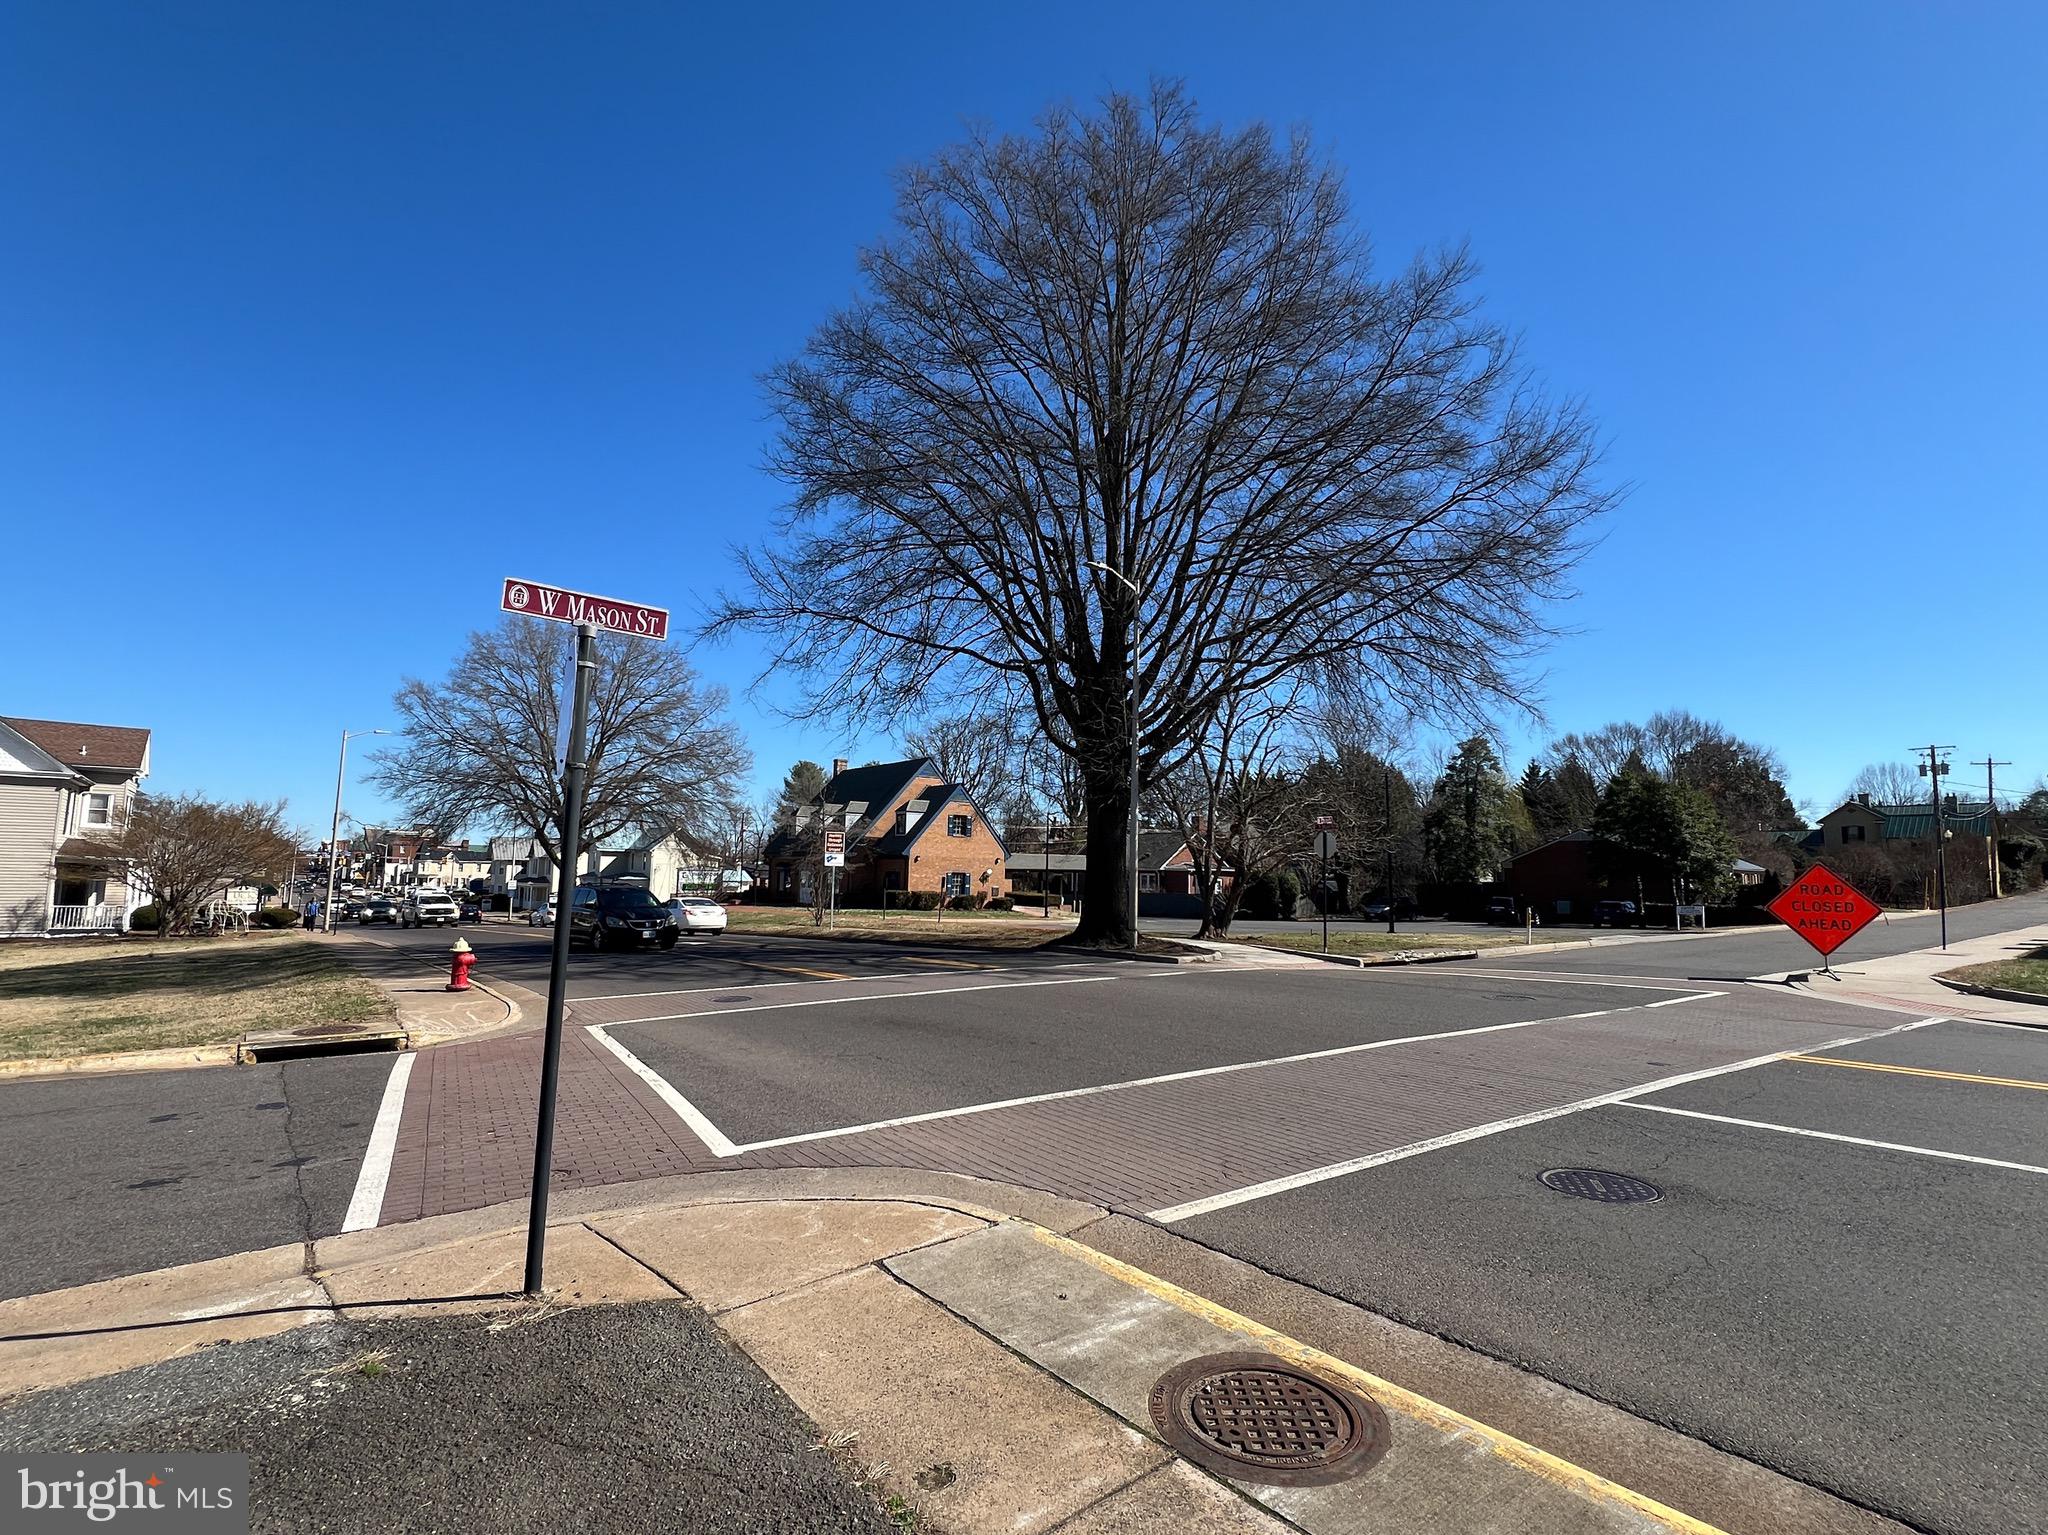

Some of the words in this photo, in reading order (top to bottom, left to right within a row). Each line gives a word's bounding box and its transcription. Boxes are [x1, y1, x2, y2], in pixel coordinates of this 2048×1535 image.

[538, 588, 562, 616] W
[566, 594, 632, 631] MASON
[635, 609, 661, 637] ST.
[1800, 884, 1844, 896] ROAD
[1791, 900, 1855, 913] CLOSED
[1798, 918, 1852, 931] AHEAD
